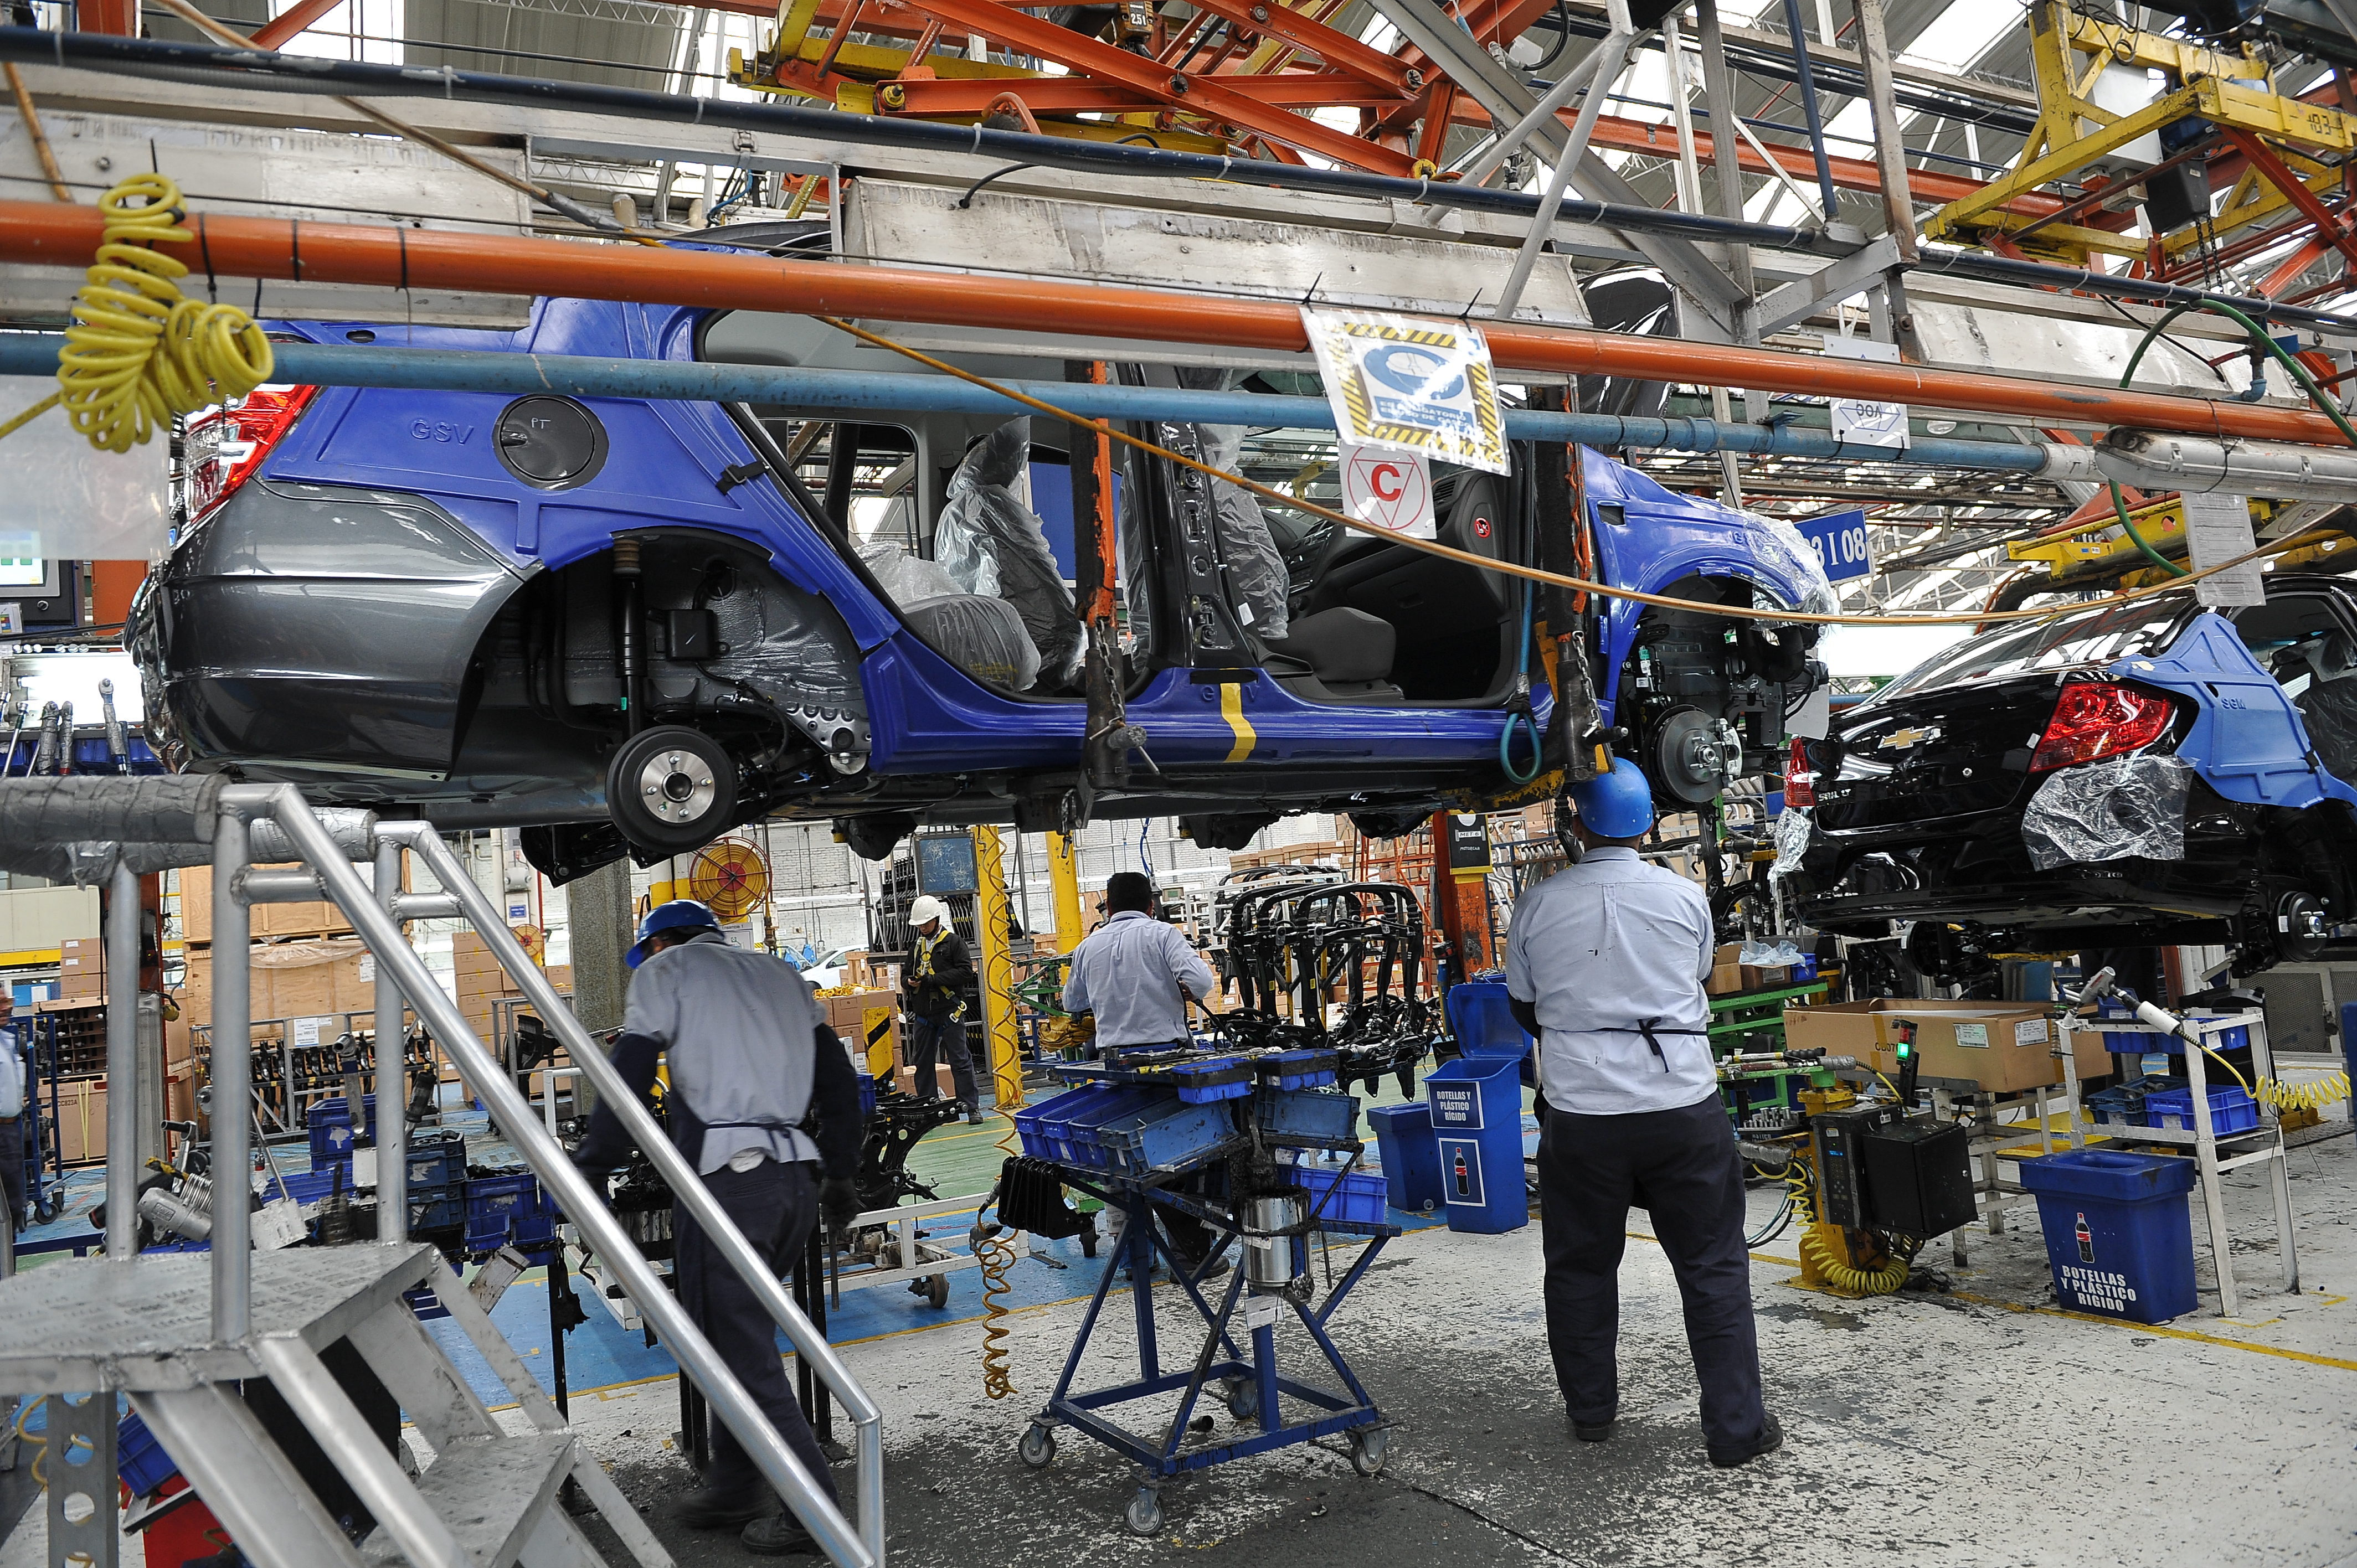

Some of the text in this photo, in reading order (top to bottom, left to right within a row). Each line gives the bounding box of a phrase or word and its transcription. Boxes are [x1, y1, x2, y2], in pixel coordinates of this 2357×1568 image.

[410, 419, 475, 446] GSV
[1371, 463, 1402, 502] C
[1437, 1091, 1471, 1100] BOTELLAS Y
[1440, 1100, 1469, 1111] PLÁSTICO
[1444, 1111, 1466, 1121] RÍGIDO
[2062, 1265, 2126, 1287] BOTELLAS
[2060, 1277, 2068, 1289] Y
